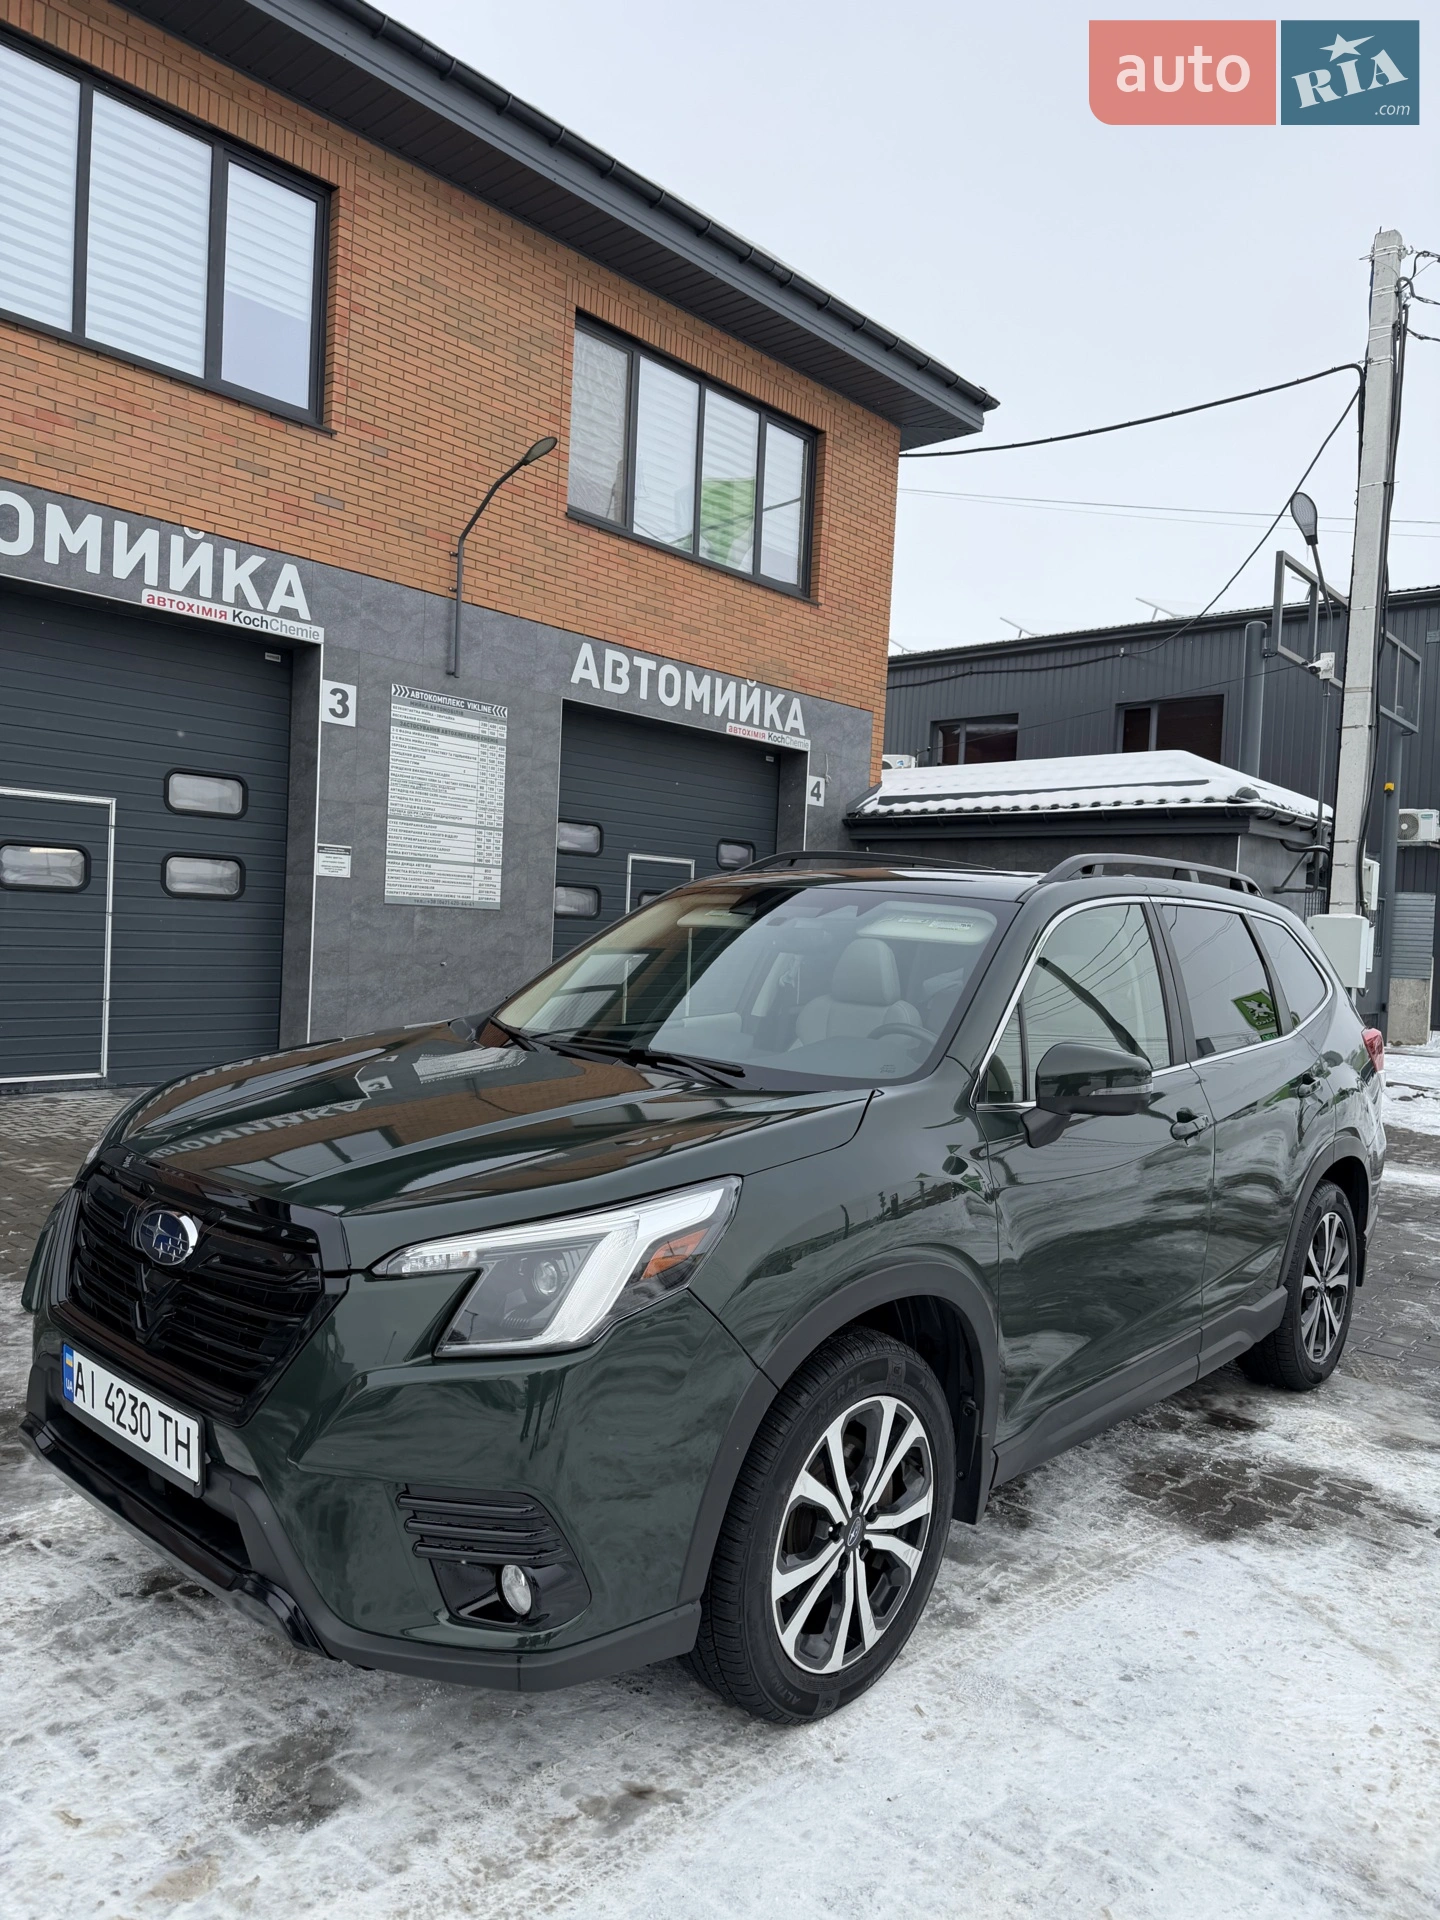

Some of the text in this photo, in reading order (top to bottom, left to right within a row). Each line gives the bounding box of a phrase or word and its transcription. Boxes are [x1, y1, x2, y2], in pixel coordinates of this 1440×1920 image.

[146, 592, 228, 621] автохімія
[328, 687, 350, 719] 3
[410, 690, 492, 713] АВТОКОМПЛЕКС VIKLINE
[570, 642, 806, 736] АВТОМИЙКА
[728, 724, 766, 740] автохімія
[810, 780, 822, 802] 4
[75, 1361, 191, 1470] AI 4230 TH
